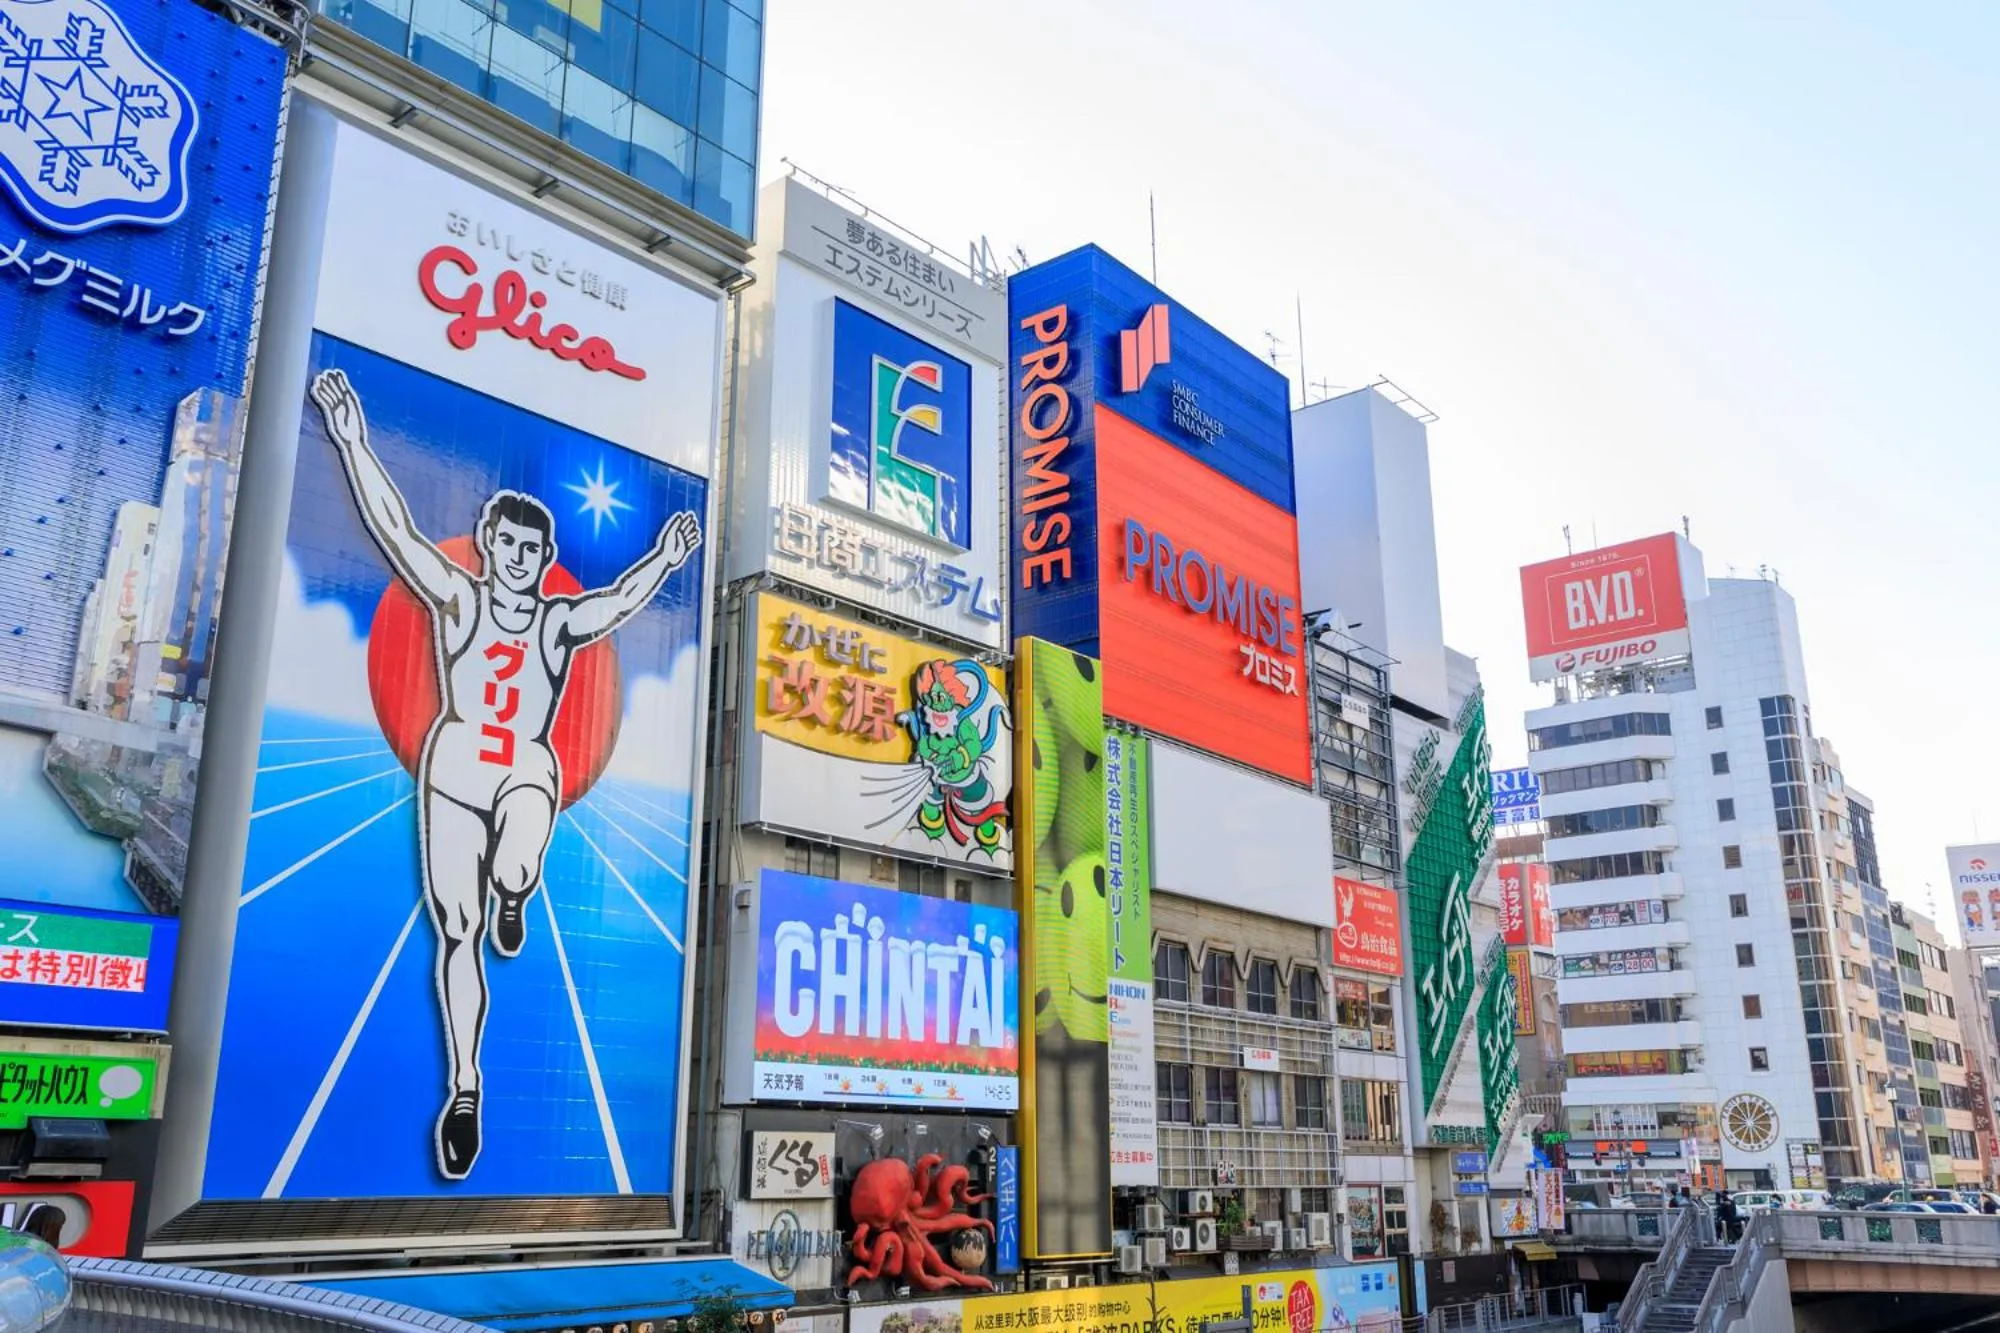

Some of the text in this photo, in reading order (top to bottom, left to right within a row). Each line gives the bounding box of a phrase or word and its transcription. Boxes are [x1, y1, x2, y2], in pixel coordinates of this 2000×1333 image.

[0, 238, 206, 335] メグミルク
[446, 210, 628, 311] おいしさと健康
[825, 244, 972, 339] エステムシリーズ
[846, 218, 954, 294] 夢ある住まい
[418, 245, 646, 381] Glico
[1172, 380, 1199, 407] SMBC
[1172, 396, 1224, 438] CONSUMER
[1173, 411, 1215, 446] FINANCE
[1021, 304, 1071, 589] PROMISE
[779, 501, 1001, 622] 日商エステム
[1124, 518, 1297, 656] PROMISE
[781, 612, 887, 674] かぜに
[1239, 643, 1299, 697] プロミス
[1580, 639, 1657, 666] FUJIBO
[479, 639, 529, 767] グリコ
[768, 655, 897, 742] 改源
[1107, 735, 1125, 972] 株式会社日本リート
[1507, 877, 1522, 931] カラオケ
[1422, 889, 1472, 1030] エイブル
[0, 1063, 90, 1105] ピタットハウス
[763, 1073, 805, 1092] 天気予報
[768, 1139, 820, 1189] くくる
